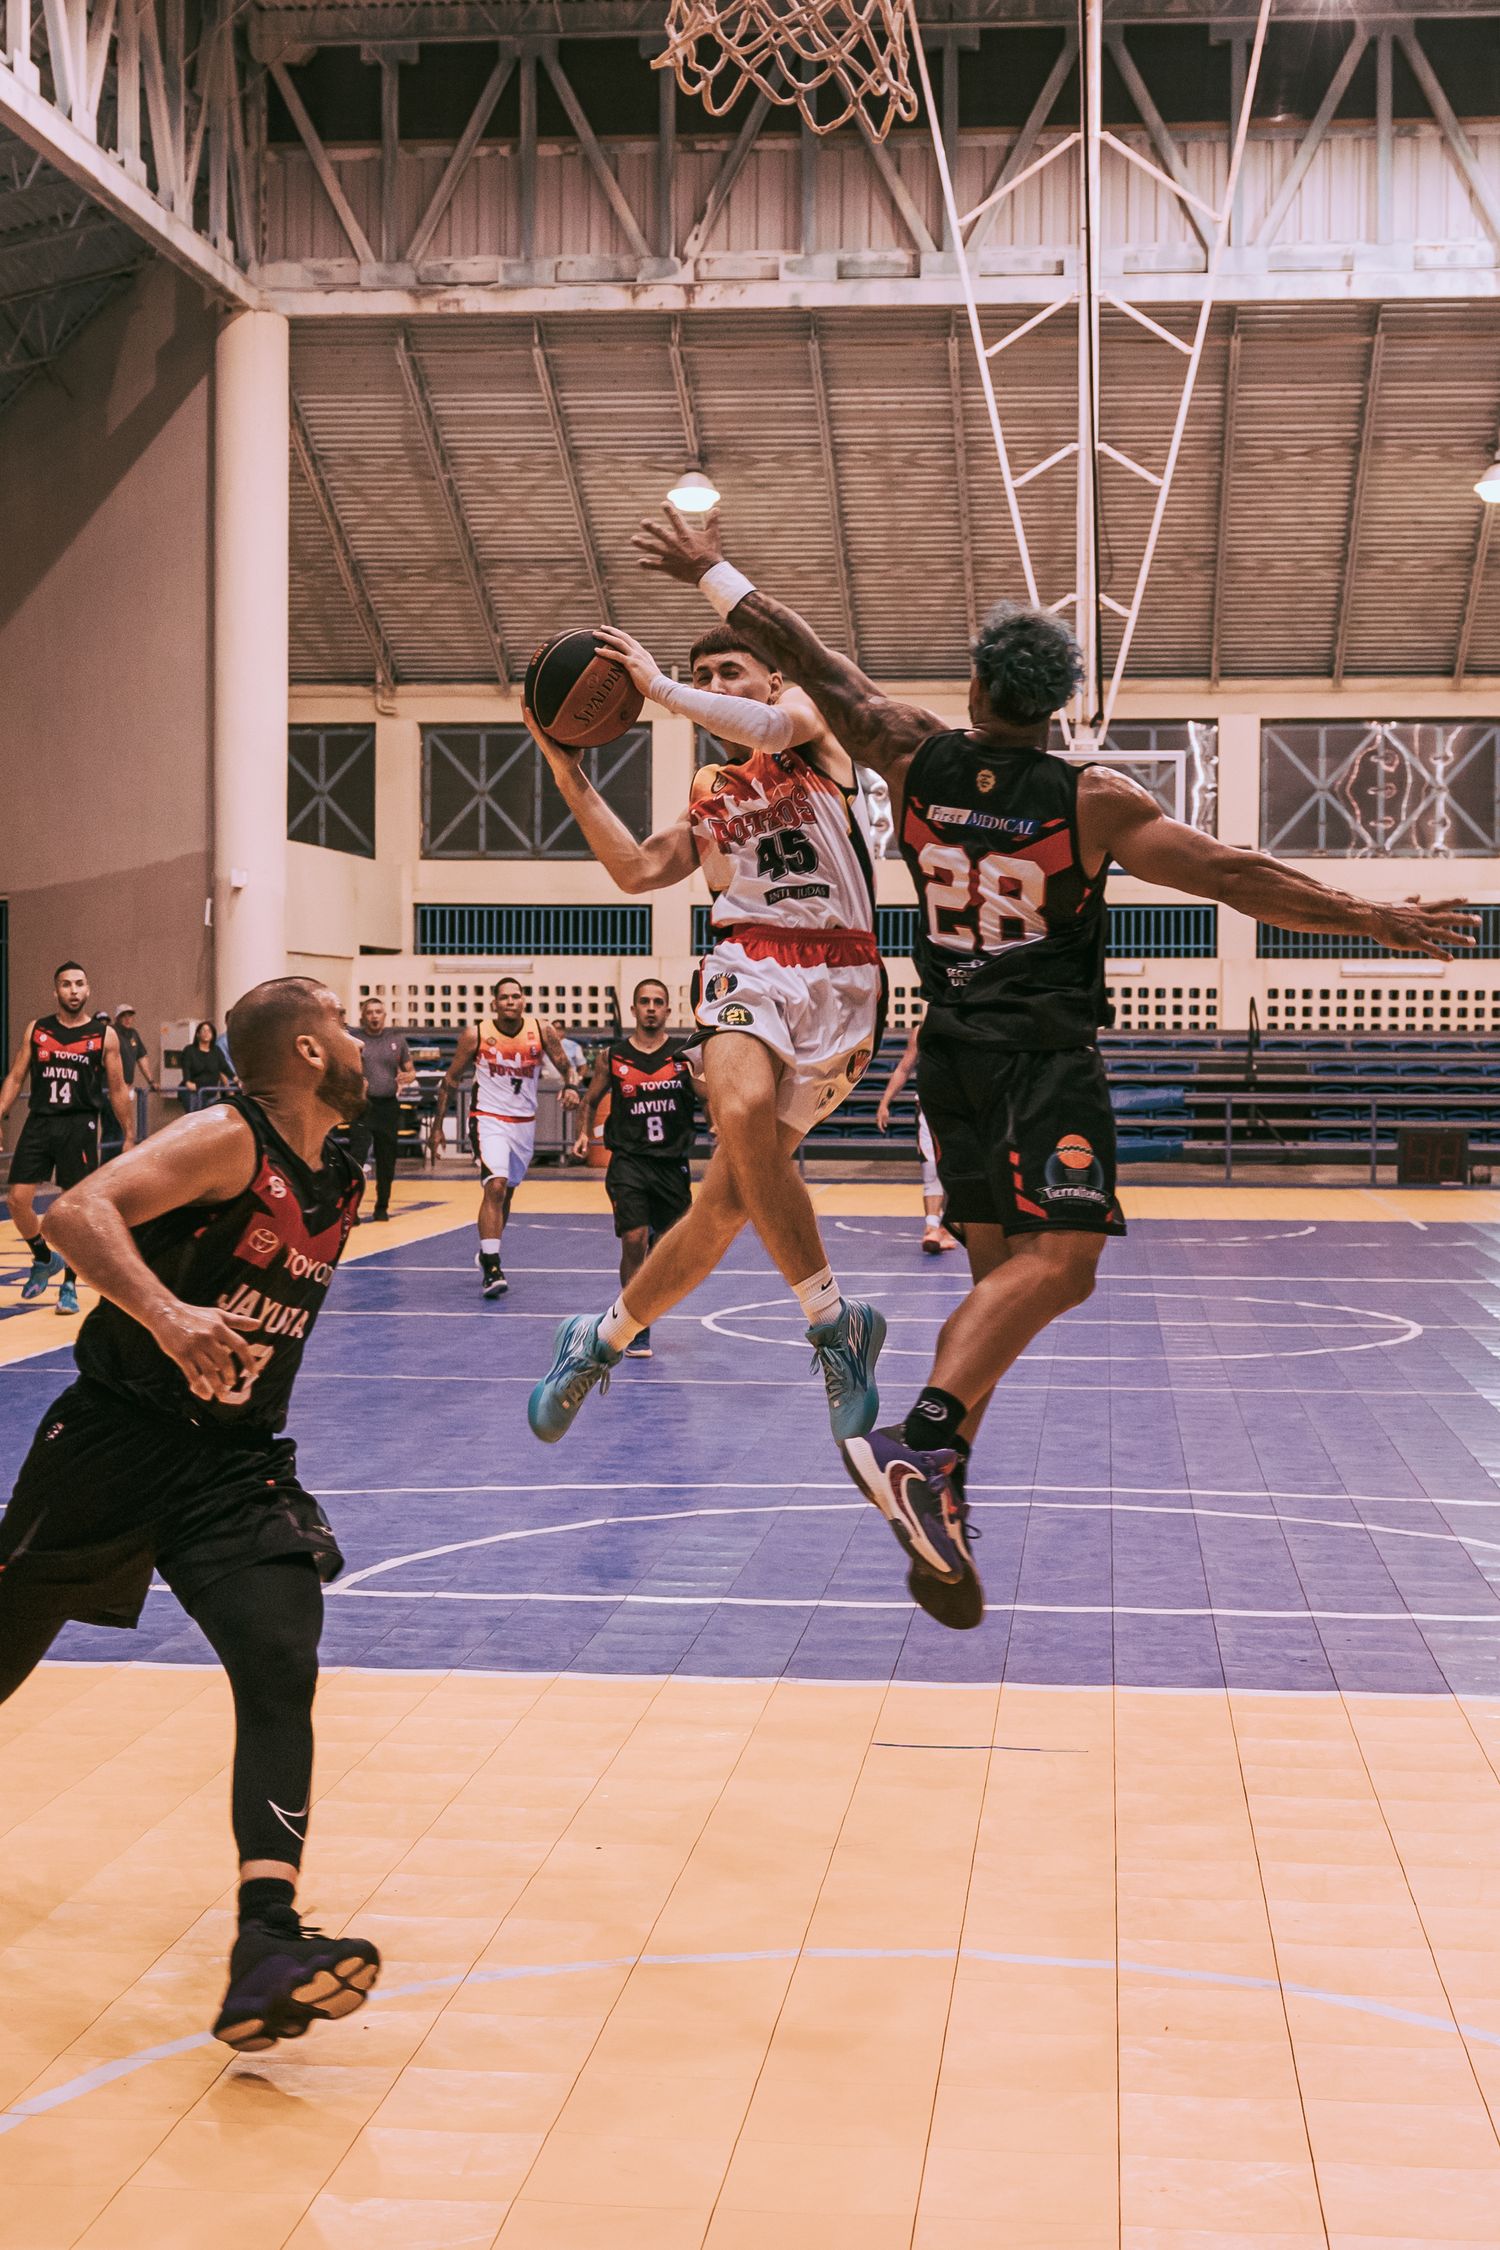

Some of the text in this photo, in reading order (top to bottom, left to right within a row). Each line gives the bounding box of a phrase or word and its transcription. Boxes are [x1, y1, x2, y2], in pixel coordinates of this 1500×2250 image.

[573, 661, 624, 726] SPALDIN
[708, 785, 817, 855] POTROS
[932, 807, 1035, 835] First MEDICAL
[756, 829, 819, 882] 45
[797, 886, 826, 900] JUDAS
[918, 842, 1048, 956] 28
[54, 1050, 90, 1065] TOYOTA
[42, 1066, 78, 1082] JAYUYA
[640, 1080, 682, 1092] TOYOTA
[49, 1081, 71, 1104] 14
[510, 1077, 523, 1096] 7
[630, 1099, 676, 1115] JAYUYA
[647, 1116, 664, 1142] 8
[216, 1283, 310, 1340] JAYUYA
